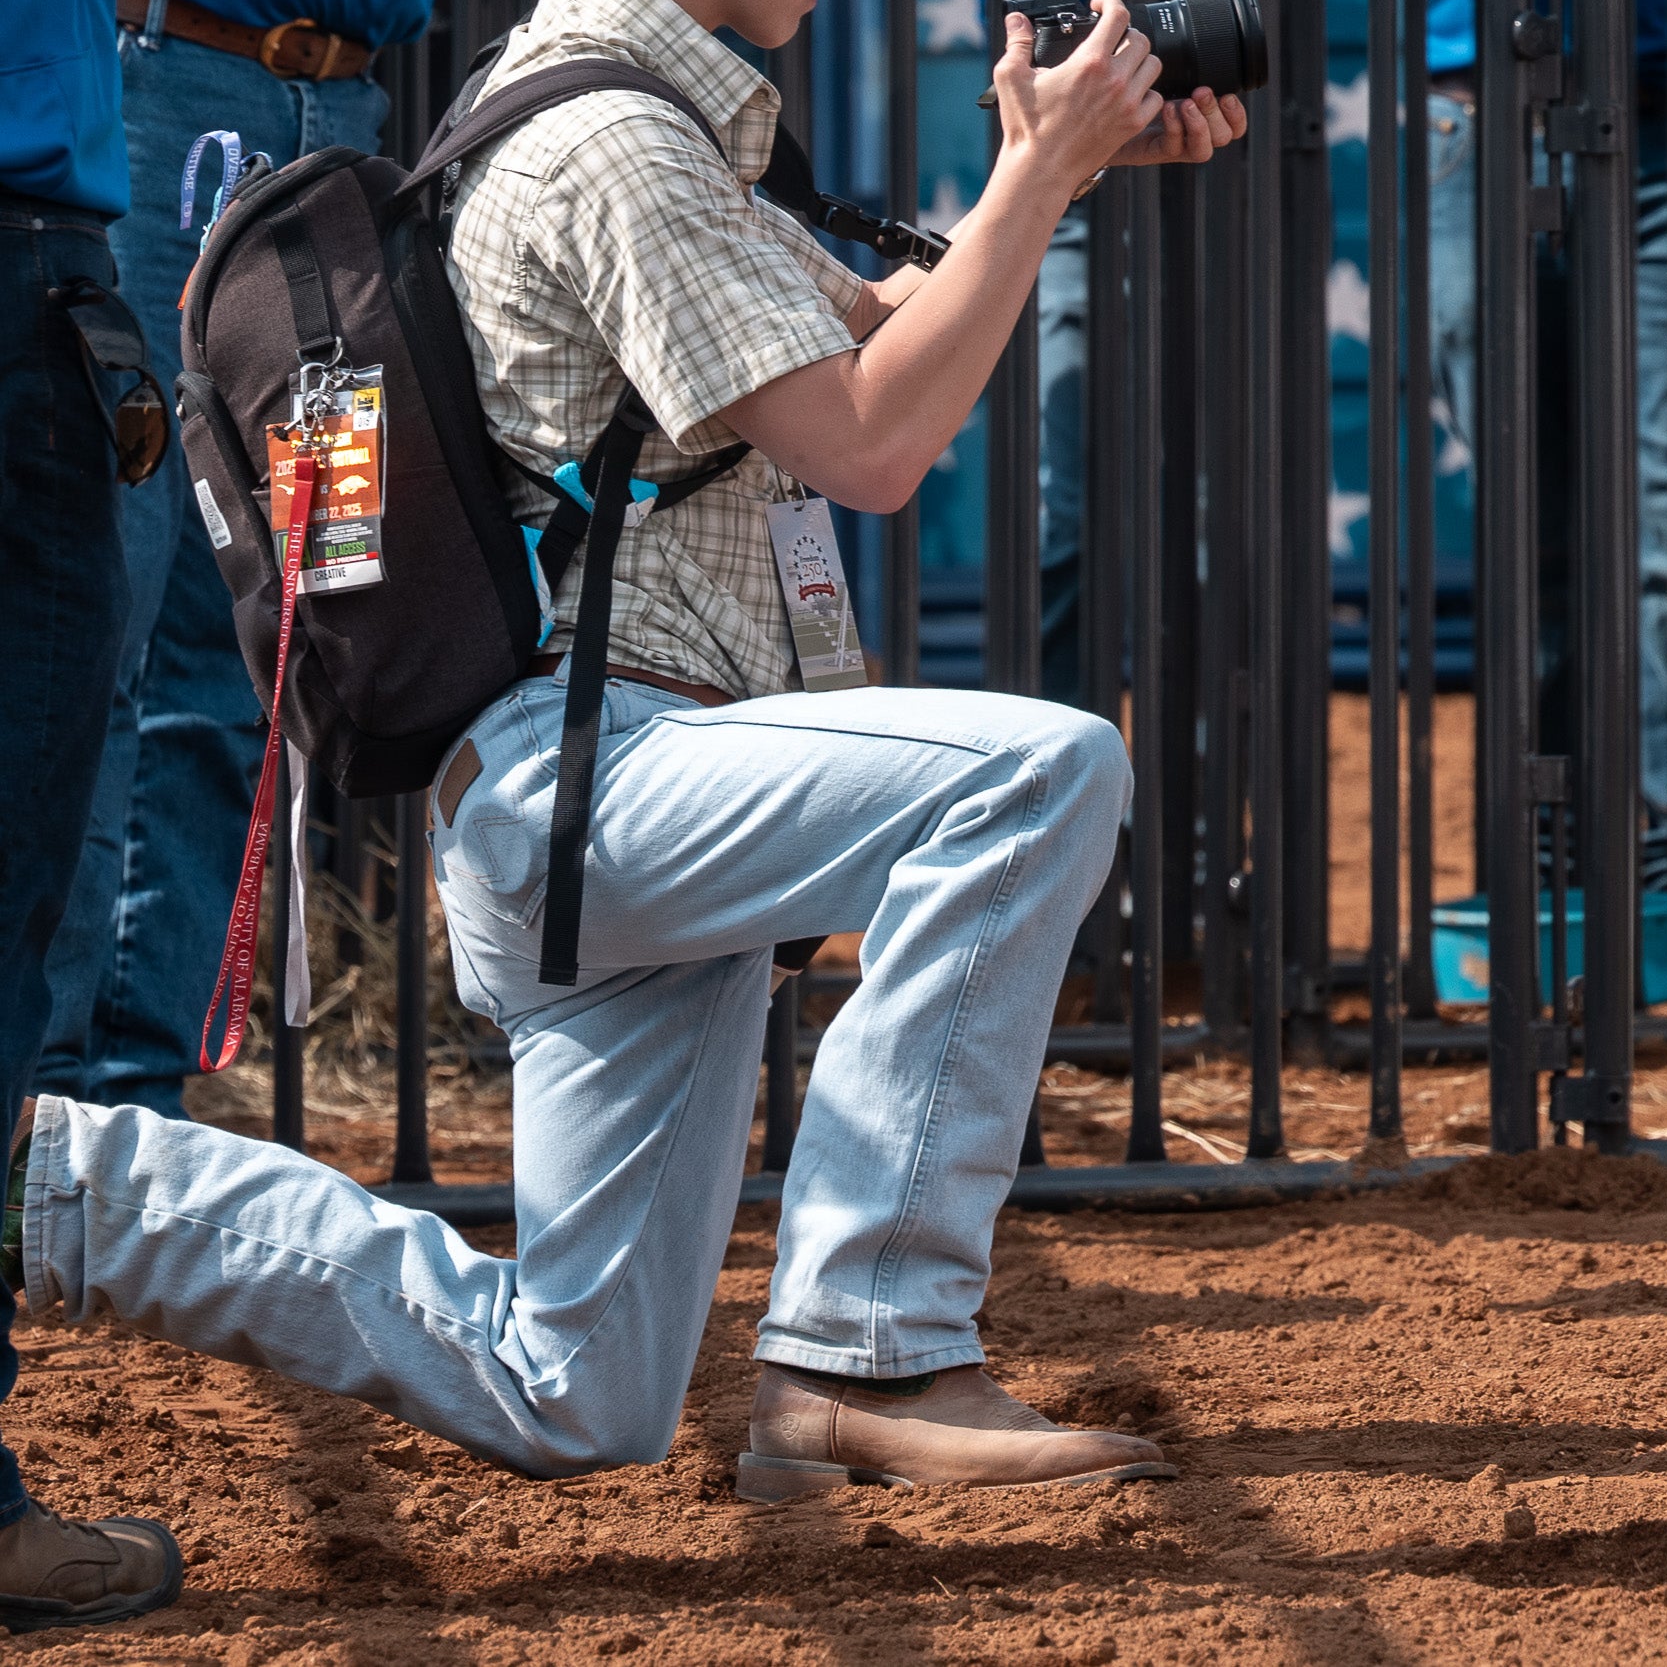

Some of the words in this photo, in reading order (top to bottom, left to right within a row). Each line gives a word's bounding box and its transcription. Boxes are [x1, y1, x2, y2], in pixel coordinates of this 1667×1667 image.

[329, 506, 341, 519] 22,
[342, 502, 363, 517] 2025
[289, 520, 304, 554] THE
[325, 545, 337, 559] ALL
[339, 541, 366, 555] ACCESS
[314, 566, 347, 582] CREATIVE
[802, 561, 823, 582] 250
[278, 557, 299, 649] UNIVERSITY
[236, 896, 248, 917] OF
[243, 822, 268, 894] ALABAMA
[236, 949, 250, 971] OF
[226, 973, 247, 1048] ALABAMA
